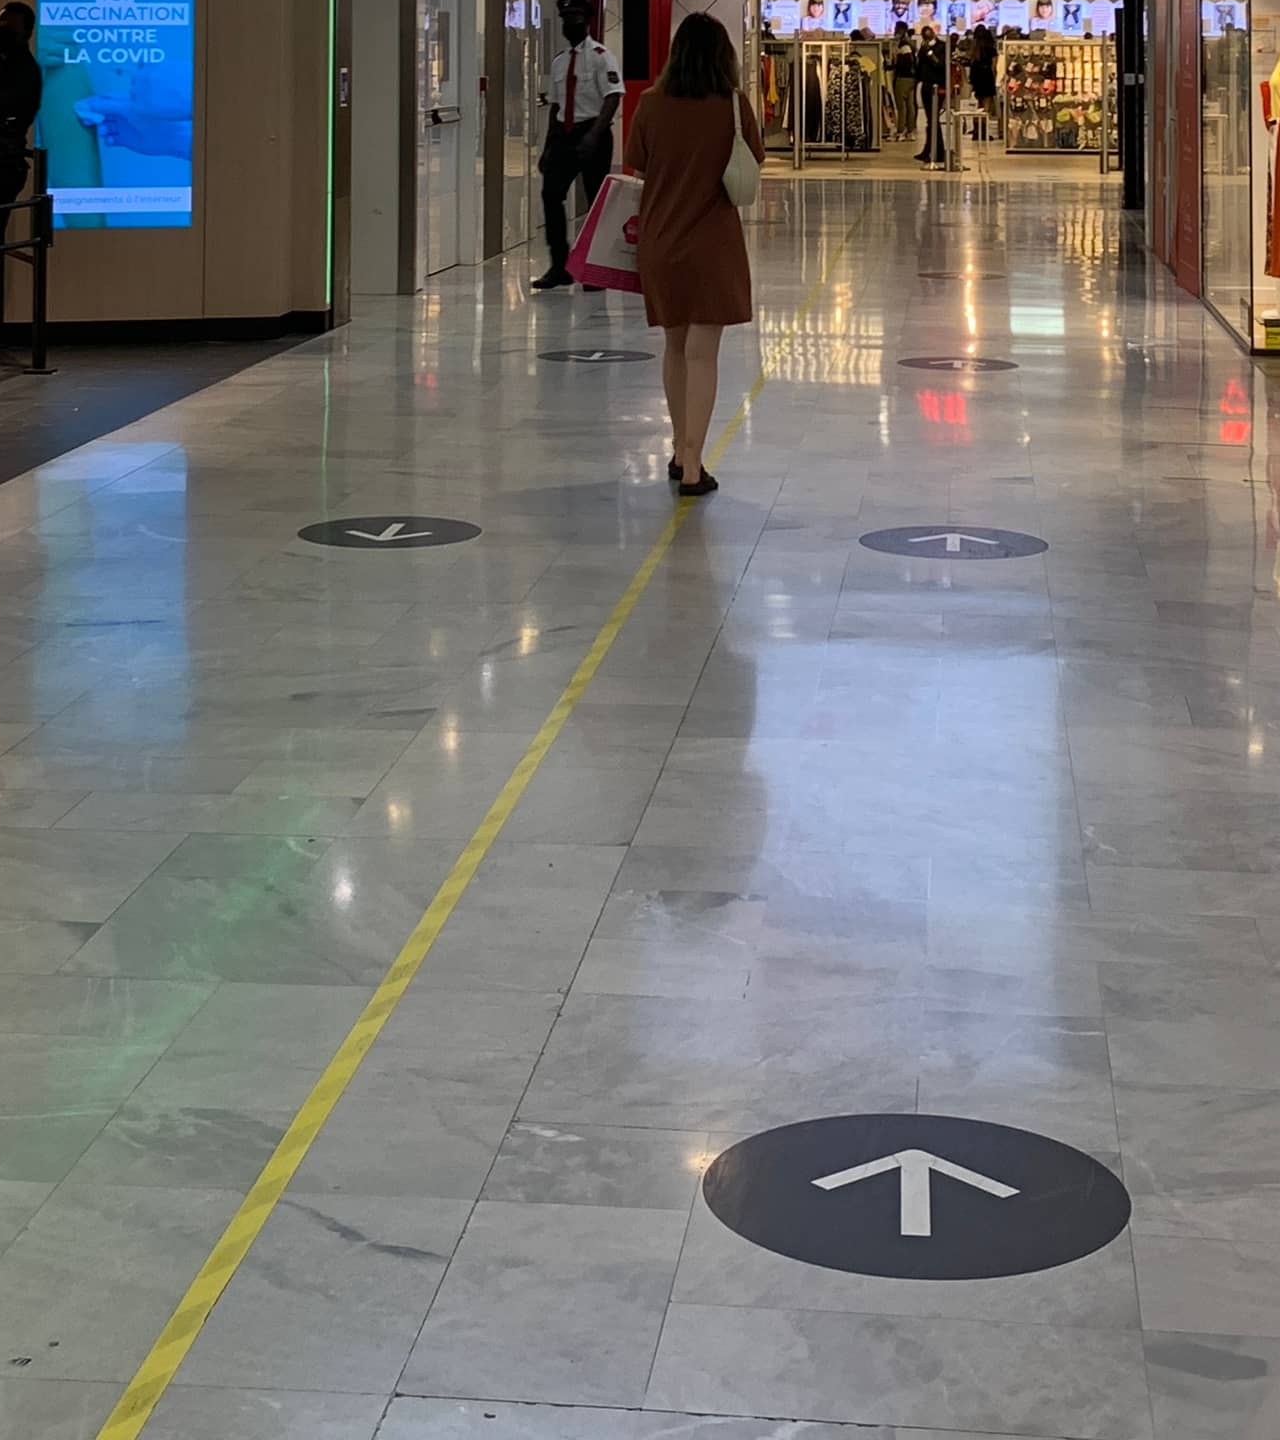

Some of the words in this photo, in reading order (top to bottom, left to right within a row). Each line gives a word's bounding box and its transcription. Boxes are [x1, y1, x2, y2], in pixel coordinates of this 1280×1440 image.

[46, 6, 186, 22] VACCINATION
[73, 28, 158, 44] CONTRE
[63, 48, 91, 64] LA
[97, 48, 166, 64] COVID
